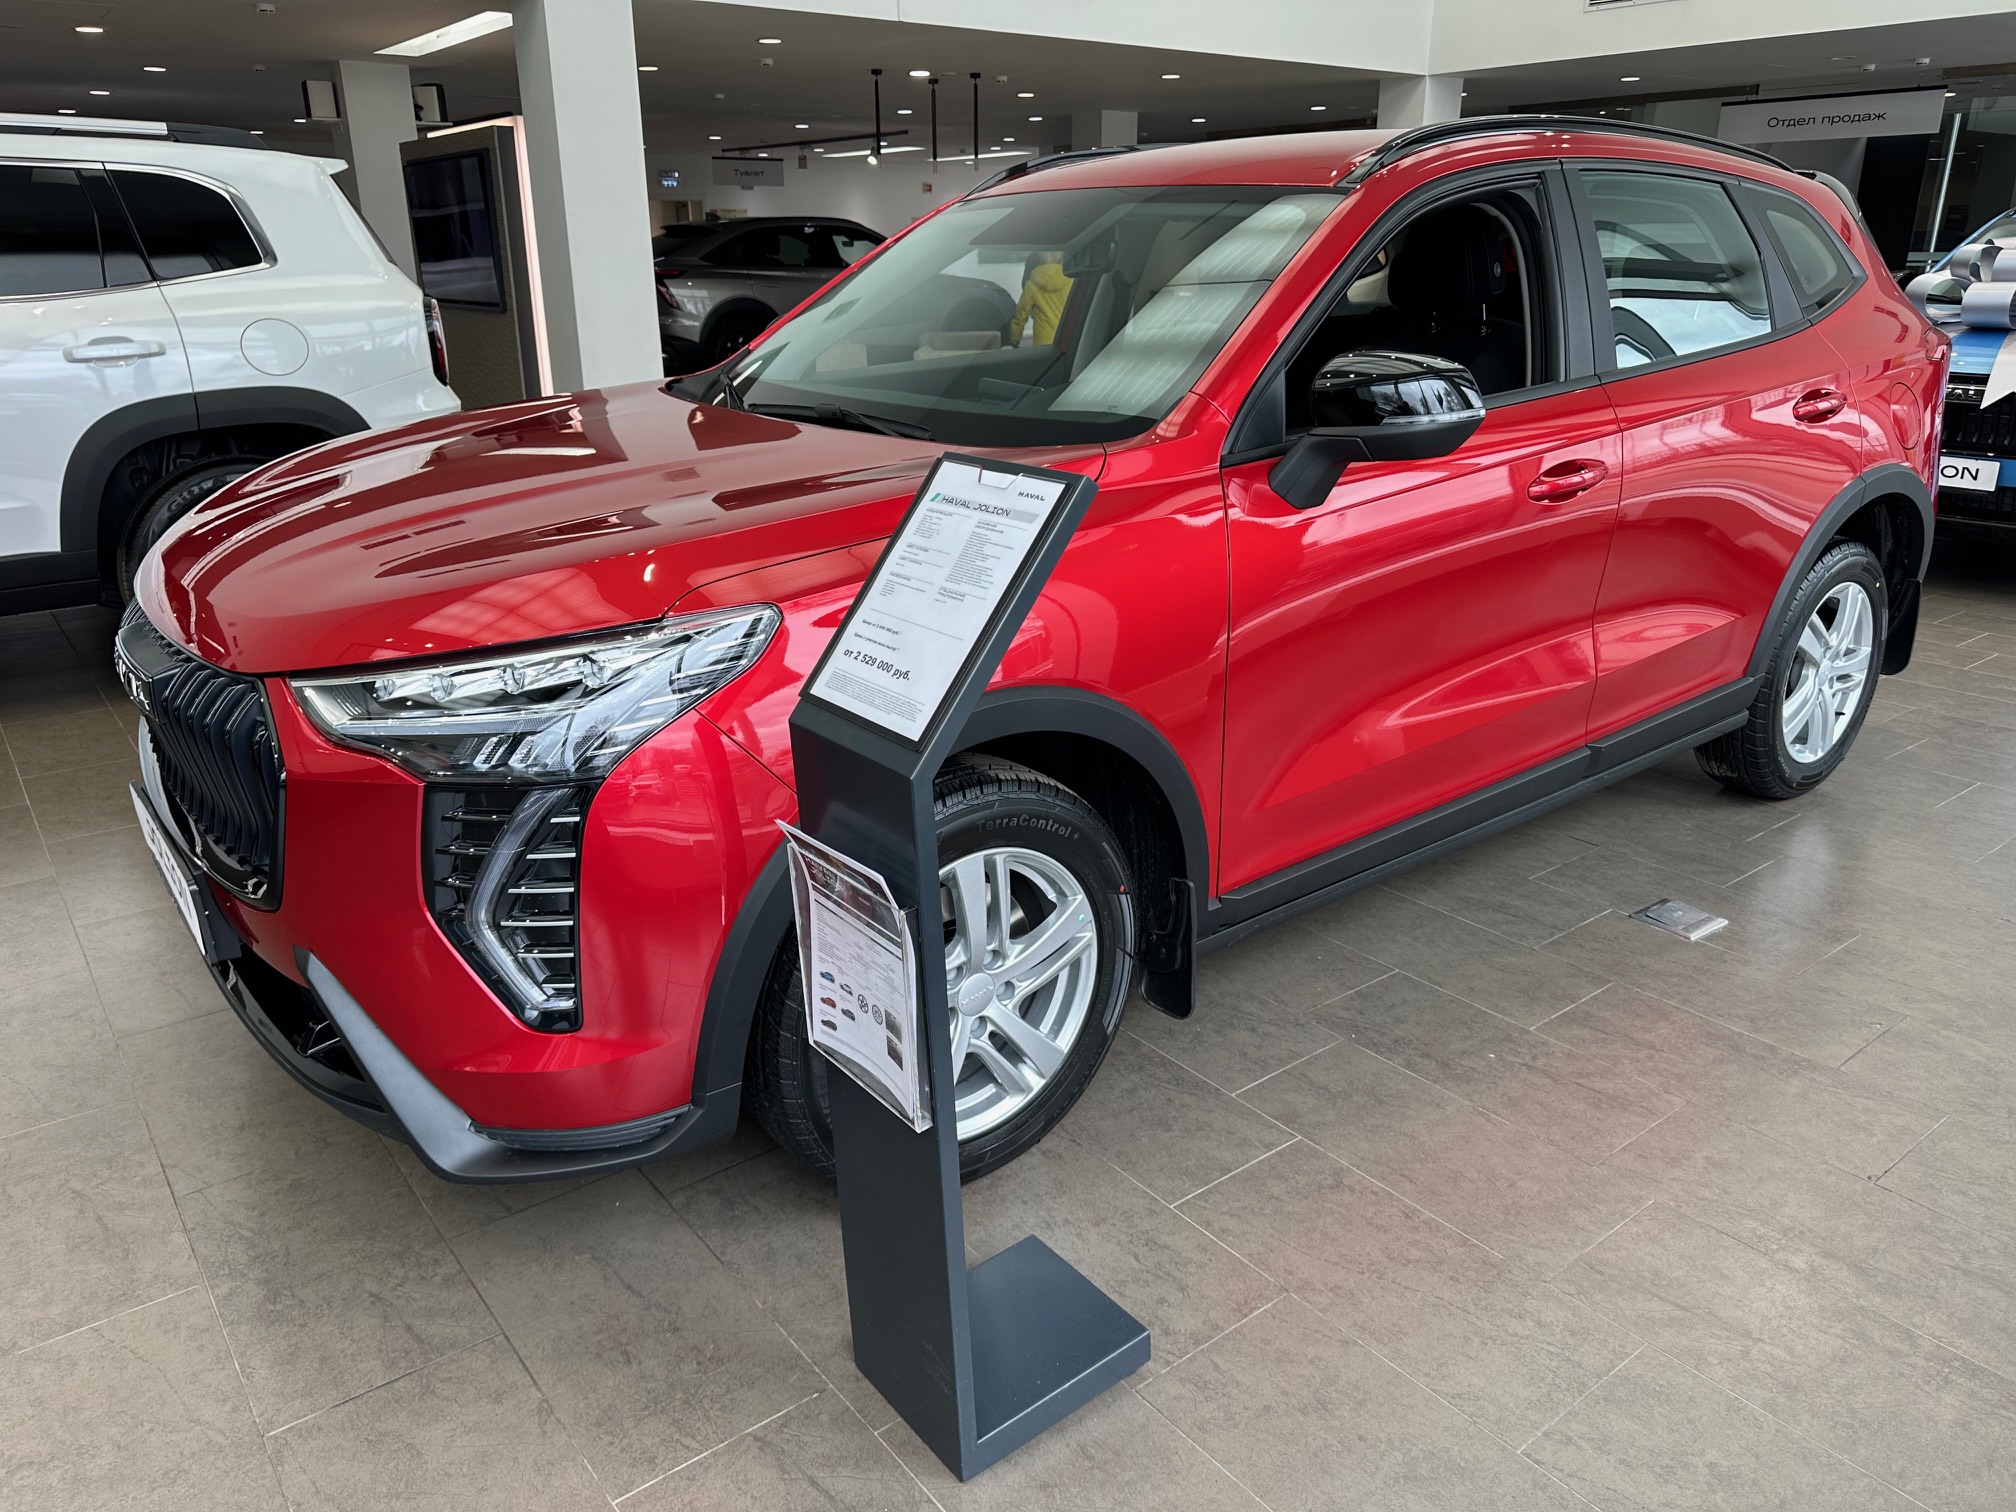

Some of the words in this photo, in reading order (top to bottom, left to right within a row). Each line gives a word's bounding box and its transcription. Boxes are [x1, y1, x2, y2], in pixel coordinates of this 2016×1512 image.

[1767, 117, 1816, 128] Отдел
[1821, 112, 1887, 126] продаж
[732, 168, 765, 178] Туалет
[1018, 491, 1045, 501] HAVAL
[941, 495, 971, 509] HAVAL
[973, 503, 1012, 517] JOLION
[843, 649, 854, 657] от
[853, 651, 862, 661] 2
[860, 654, 877, 667] 529
[876, 660, 894, 673] 000
[891, 669, 911, 681] руб.
[975, 813, 1072, 839] TerraControl
